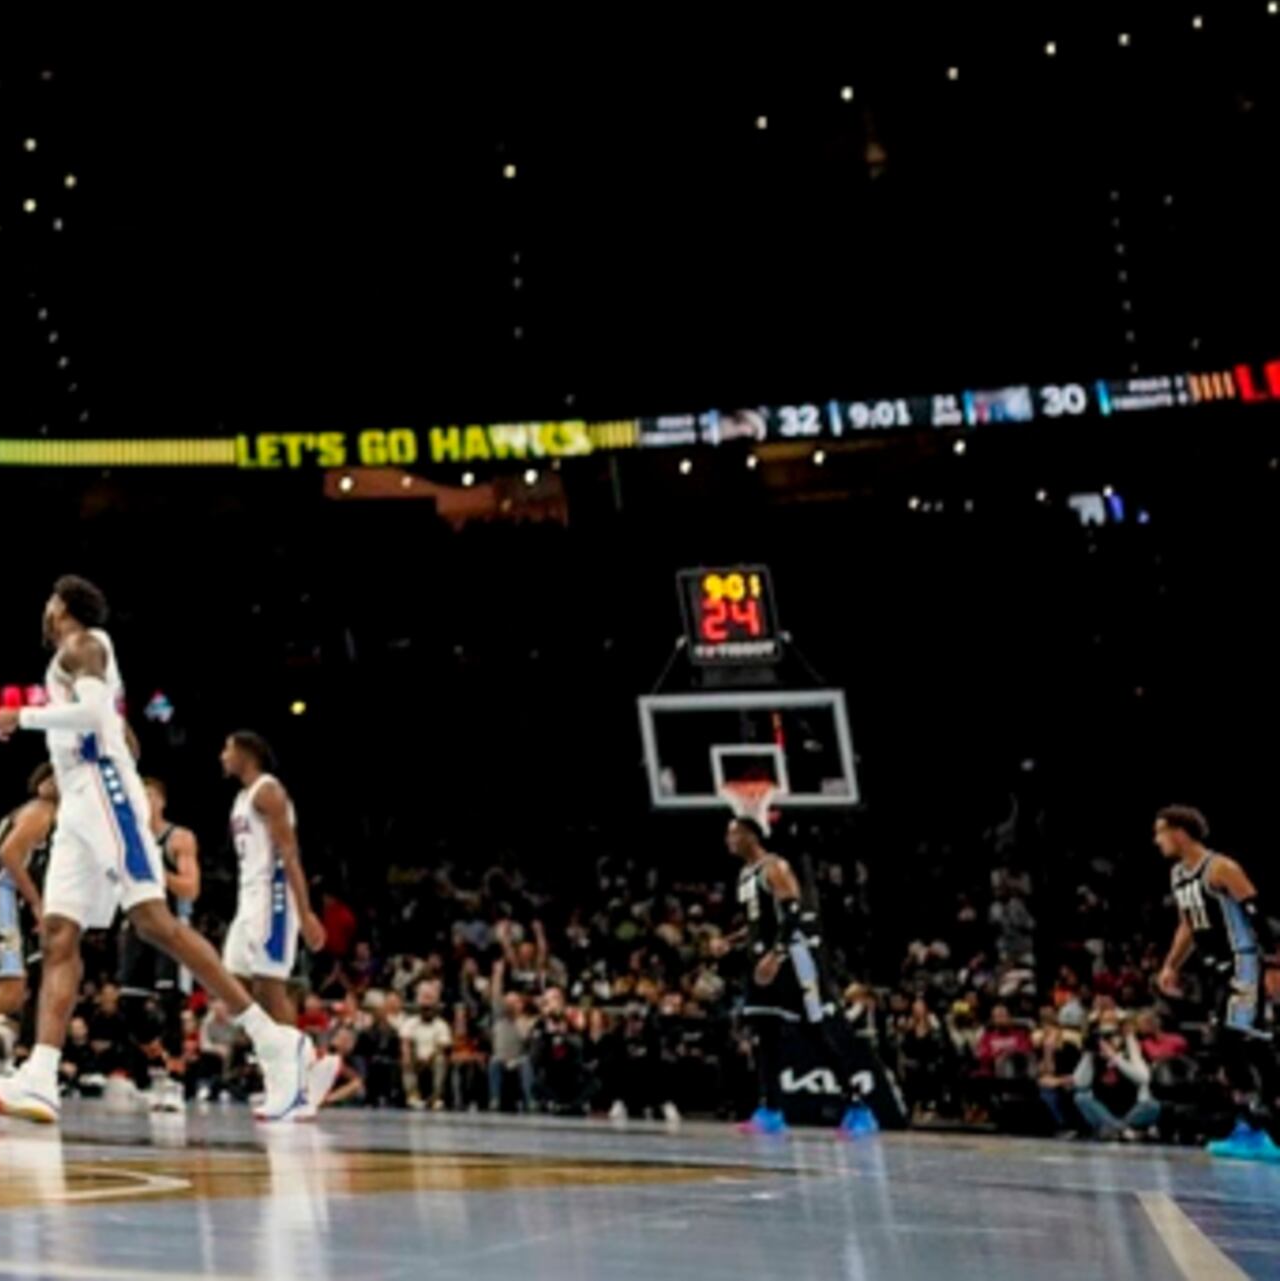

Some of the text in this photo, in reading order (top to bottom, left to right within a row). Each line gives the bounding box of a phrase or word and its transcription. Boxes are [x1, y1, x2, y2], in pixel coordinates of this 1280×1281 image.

[848, 397, 911, 428] 9:01
[1040, 383, 1088, 417] 30
[777, 405, 822, 437] 32
[237, 419, 595, 469] LET'S GO HAWKS
[701, 599, 760, 640] 24
